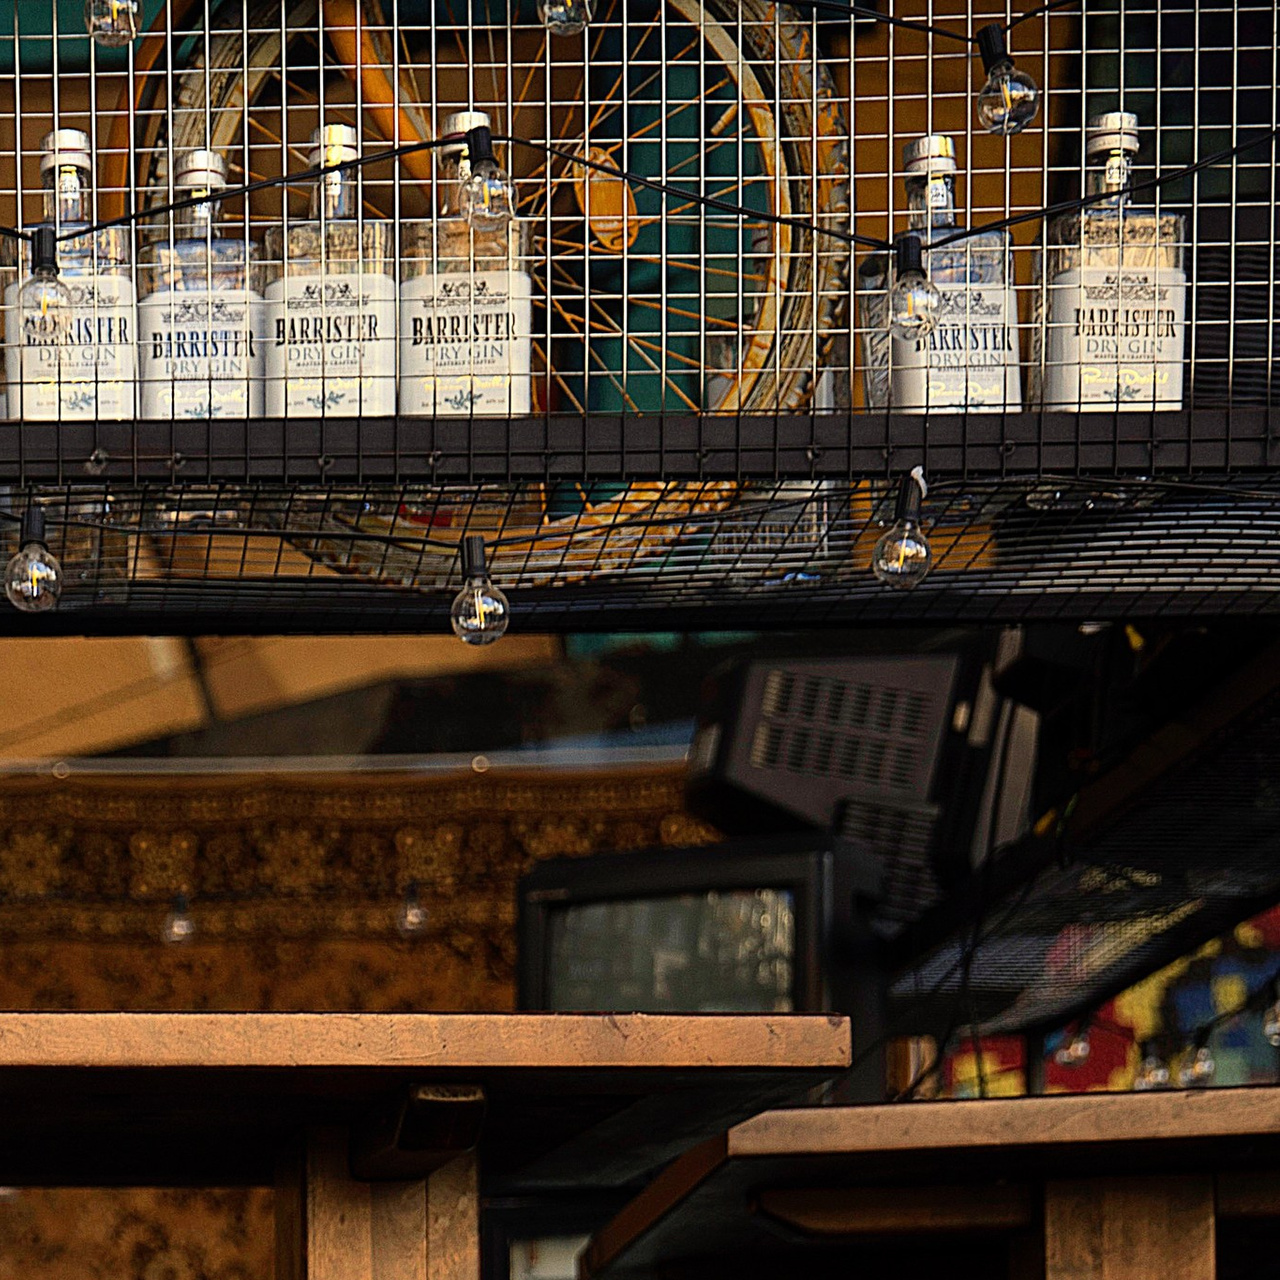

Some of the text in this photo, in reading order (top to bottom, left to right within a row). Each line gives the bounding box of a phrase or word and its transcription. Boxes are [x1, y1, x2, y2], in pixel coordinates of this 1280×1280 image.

[276, 314, 380, 346] BARRISTER
[412, 312, 517, 345] BARRISTER
[1074, 308, 1176, 338] BARRISTER
[152, 331, 255, 358] BARRISTER
[468, 343, 503, 358] GIN
[1087, 338, 1162, 353] DRY GIN
[39, 346, 116, 362] DRY GIN
[288, 345, 366, 361] DRY GIN
[930, 353, 1001, 367] DRY GIN
[165, 360, 202, 374] DRY
